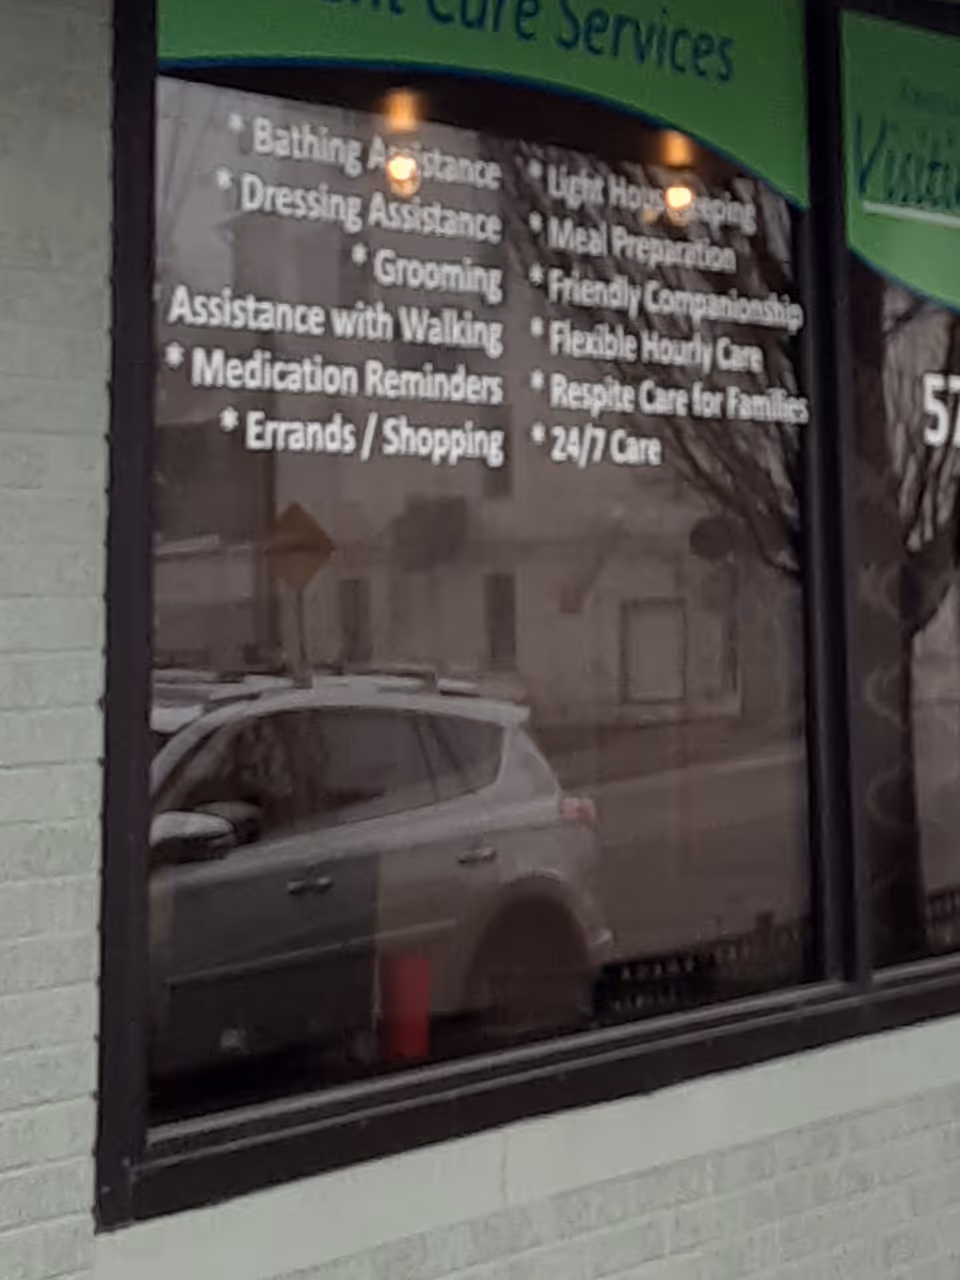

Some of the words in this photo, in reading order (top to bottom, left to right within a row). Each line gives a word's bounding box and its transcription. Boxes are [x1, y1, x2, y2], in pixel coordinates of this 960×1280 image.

[252, 116, 362, 175] Bathing
[241, 172, 362, 233] Dressing
[368, 191, 502, 244] Assistance
[548, 164, 604, 210] Light
[549, 217, 608, 257] Meal
[611, 225, 738, 274] Preparation
[374, 248, 503, 304] Grooming
[549, 267, 642, 320] Friendly
[645, 278, 804, 336] Companionship
[168, 284, 325, 336] Assistance
[330, 301, 393, 341] with
[399, 306, 503, 359] Walking
[550, 320, 638, 363] Flexible
[641, 328, 714, 375] Hourly
[715, 336, 766, 374] Care
[191, 346, 358, 396] Medication
[364, 359, 504, 406] Reminders
[550, 372, 636, 418] Respite
[638, 378, 690, 417] Care
[692, 380, 725, 419] for
[726, 385, 809, 425] Families
[245, 410, 356, 455] Errands
[383, 416, 504, 468] Shopping
[551, 422, 607, 469] 24/7
[610, 428, 662, 466] Care
